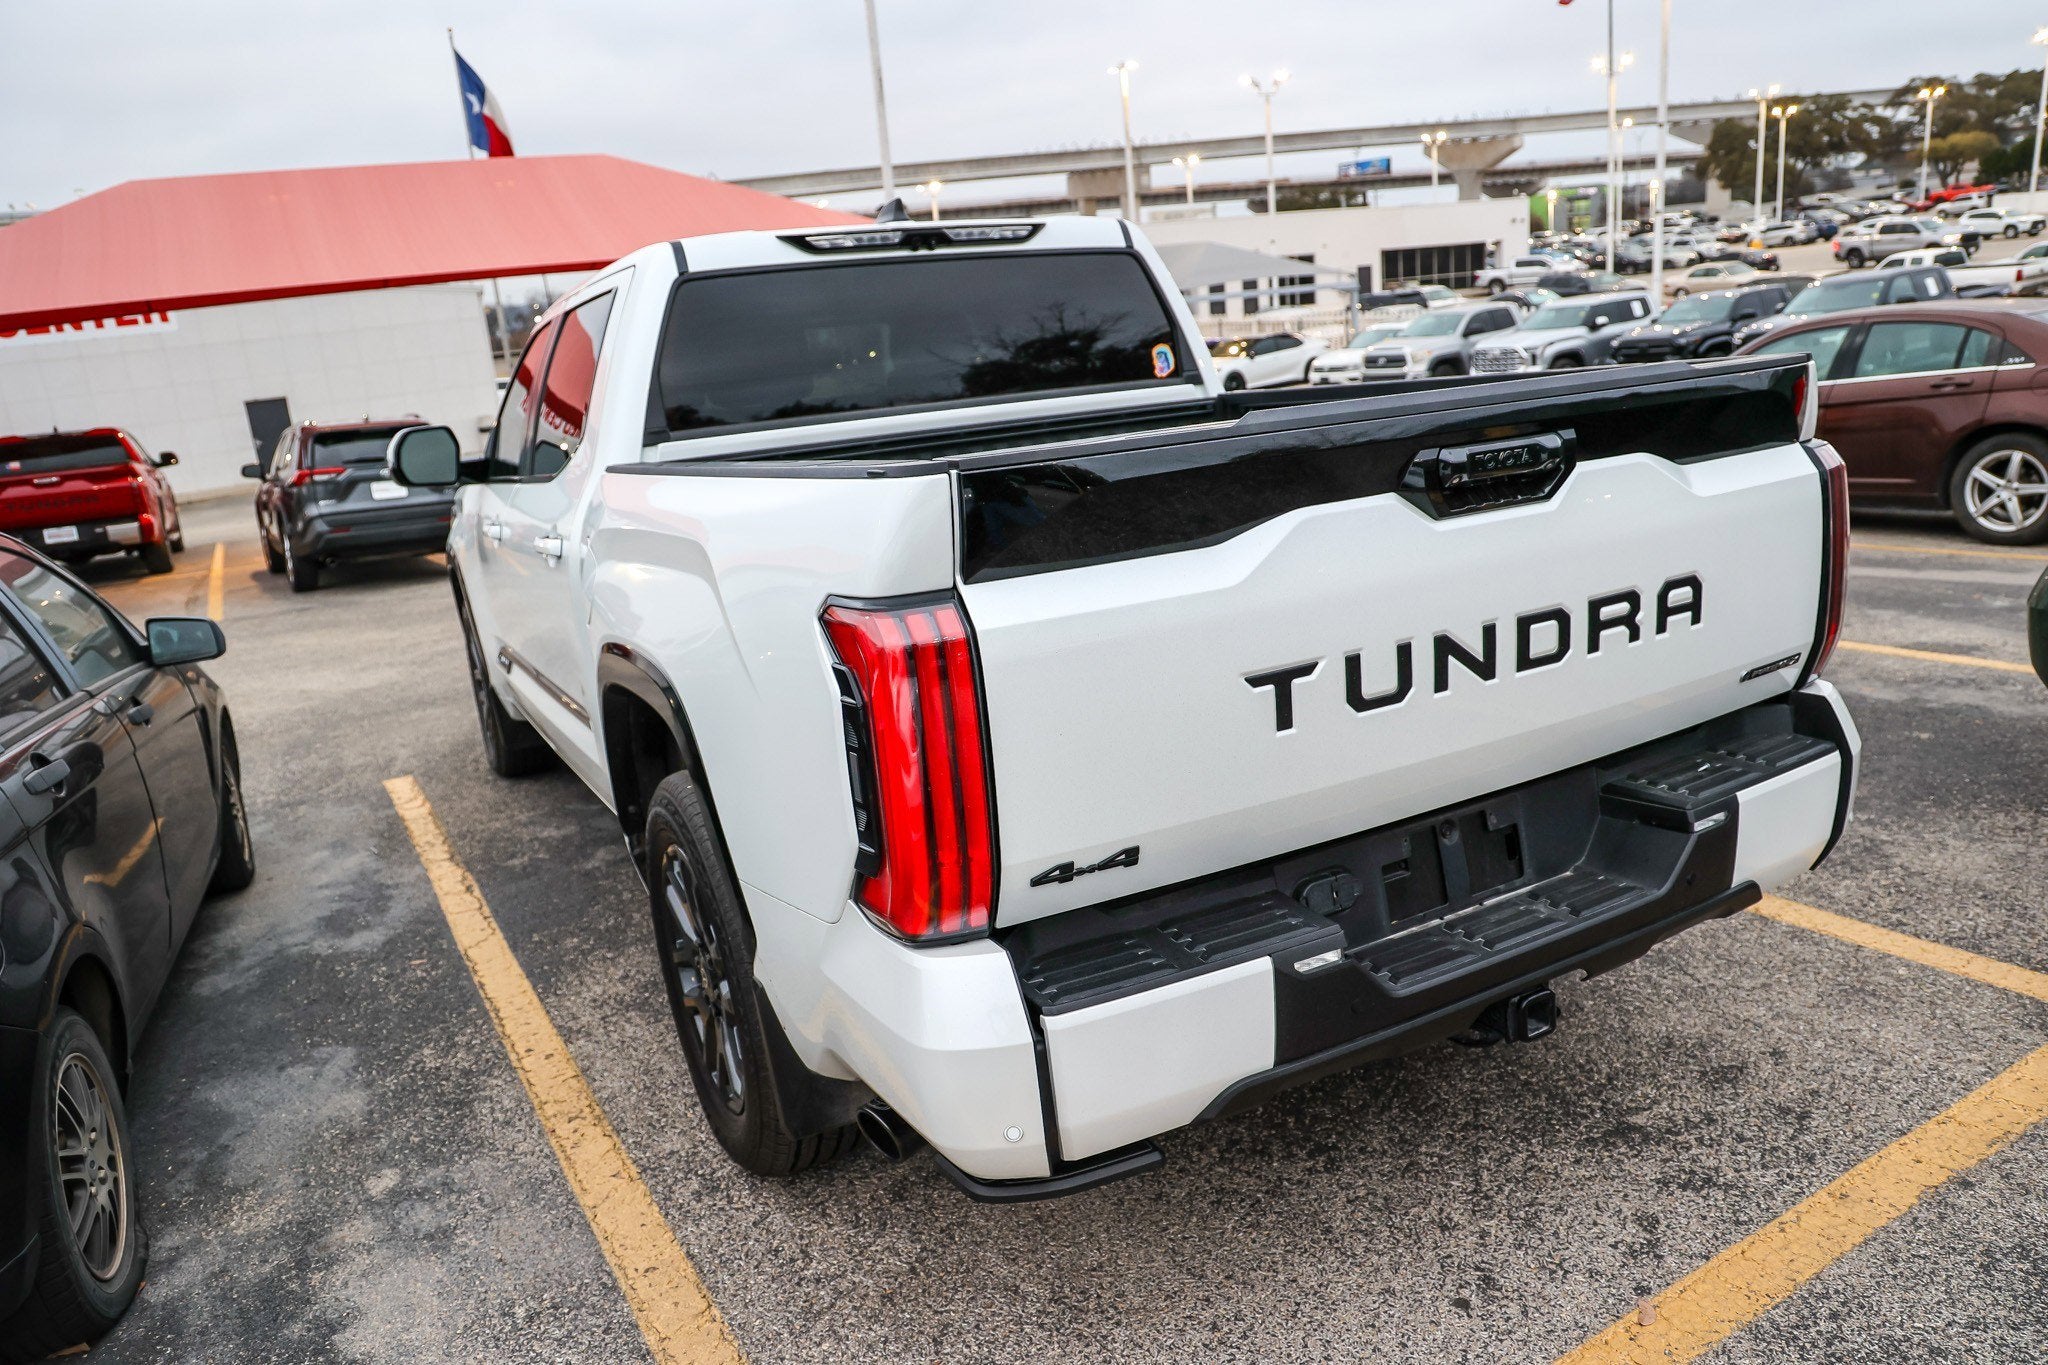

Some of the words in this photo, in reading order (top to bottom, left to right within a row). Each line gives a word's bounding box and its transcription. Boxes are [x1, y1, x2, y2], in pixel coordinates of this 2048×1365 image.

[0, 311, 169, 338] NTER
[1475, 447, 1533, 469] TOYOTA
[1242, 572, 1704, 734] TUNDRA
